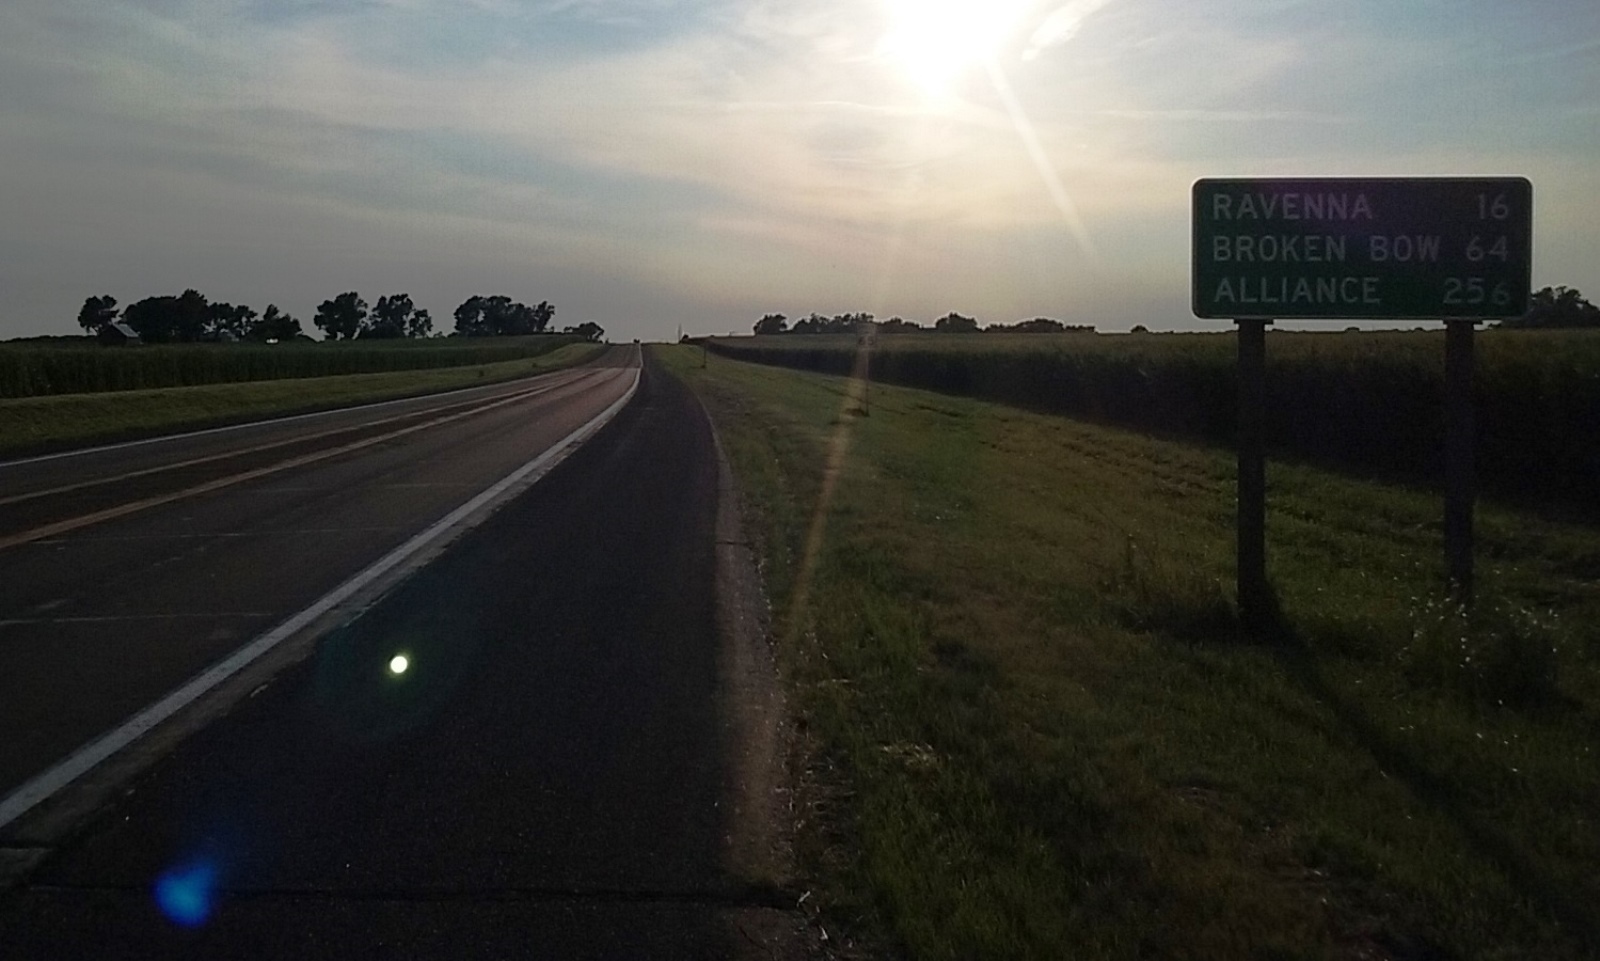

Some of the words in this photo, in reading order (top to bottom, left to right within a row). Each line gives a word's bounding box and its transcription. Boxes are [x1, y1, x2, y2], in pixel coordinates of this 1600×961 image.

[1213, 193, 1373, 221] RAVENNA
[1478, 193, 1510, 221] 16
[1213, 235, 1347, 262] BROKEN
[1369, 234, 1442, 262] BOW
[1466, 235, 1508, 262] 64
[1214, 276, 1381, 304] ALLIANCE
[1443, 277, 1511, 306] 256
